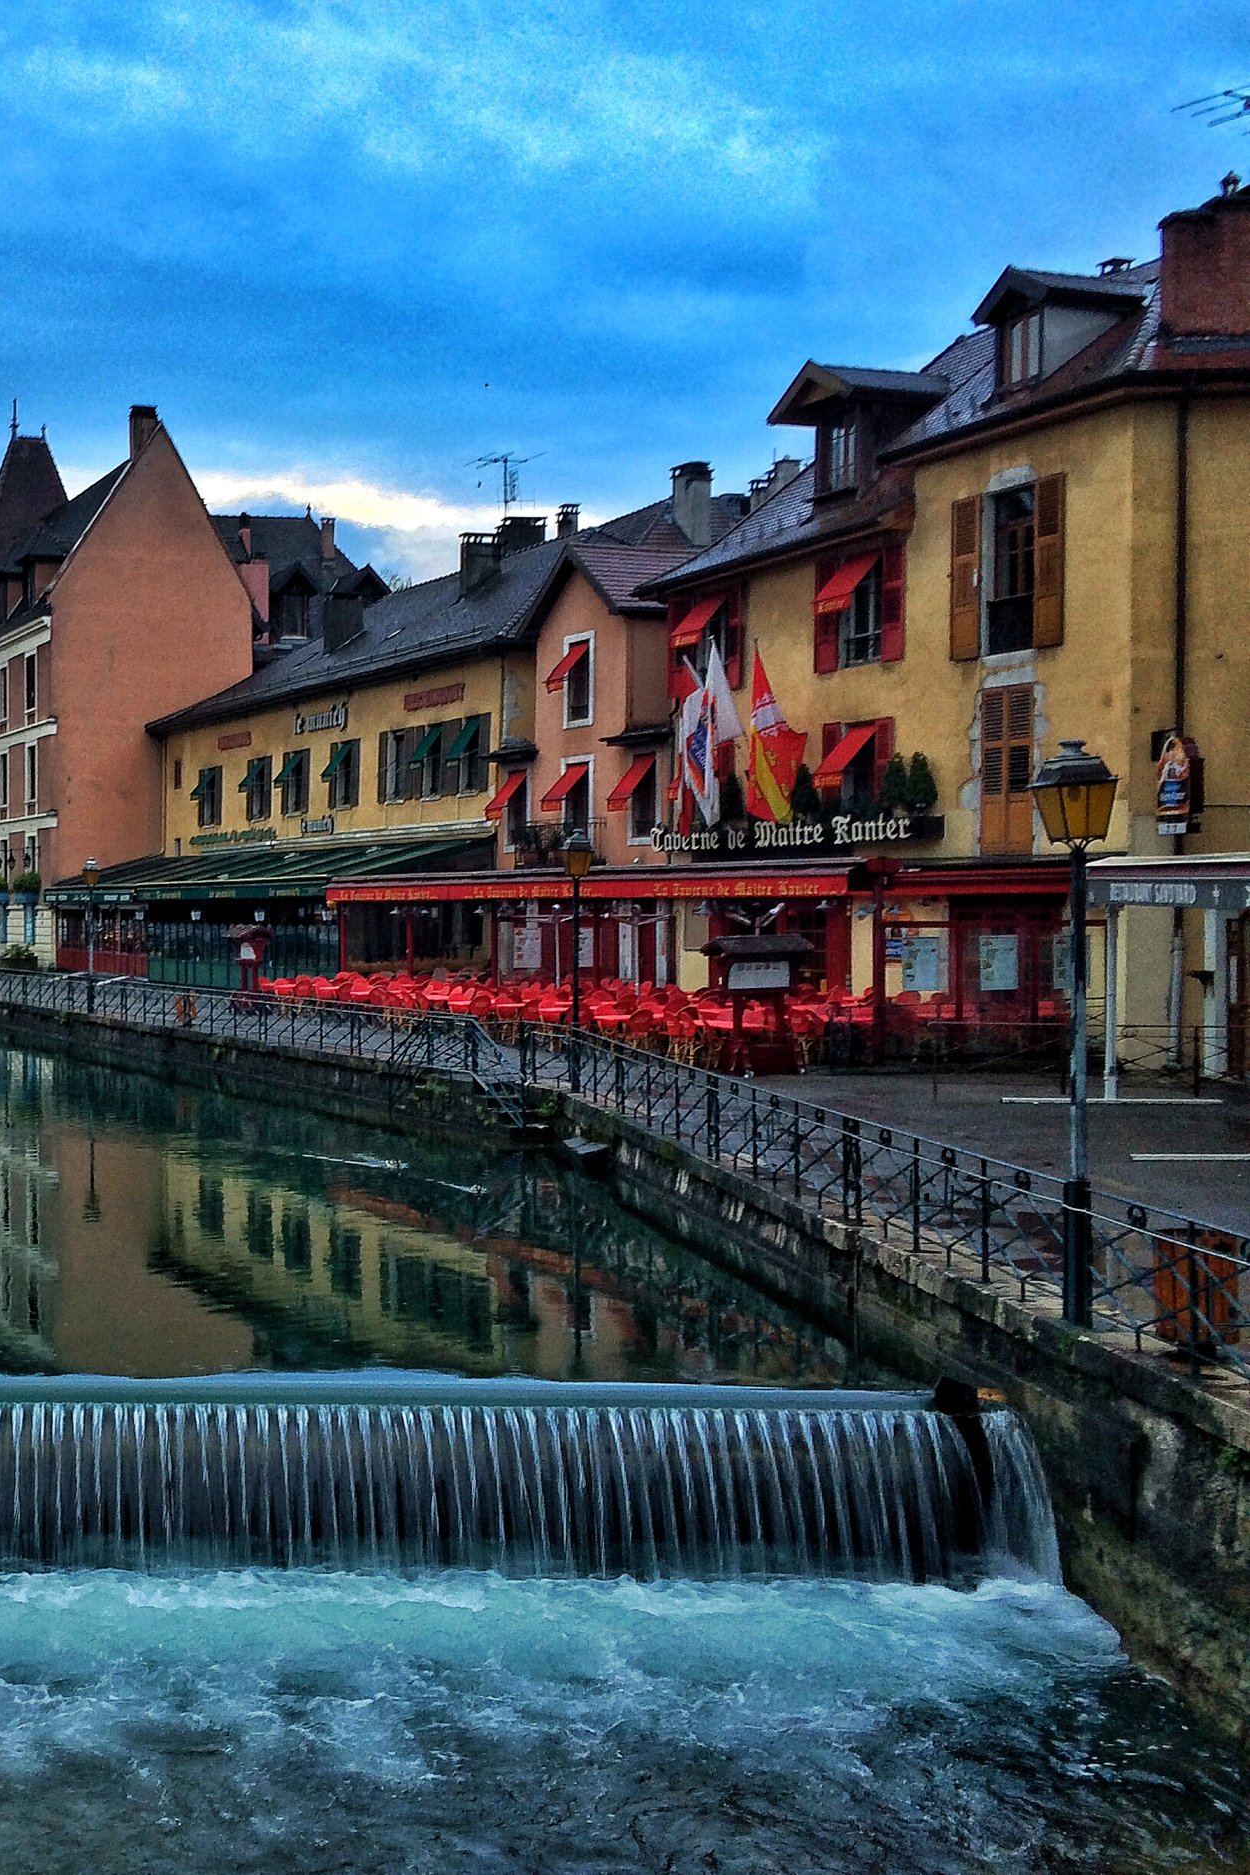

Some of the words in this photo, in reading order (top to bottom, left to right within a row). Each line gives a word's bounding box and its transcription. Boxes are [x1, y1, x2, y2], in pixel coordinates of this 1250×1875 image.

[650, 827, 720, 853] Taverne
[724, 825, 746, 850] de
[831, 812, 912, 845] Kanter
[778, 880, 819, 896] Kanter
